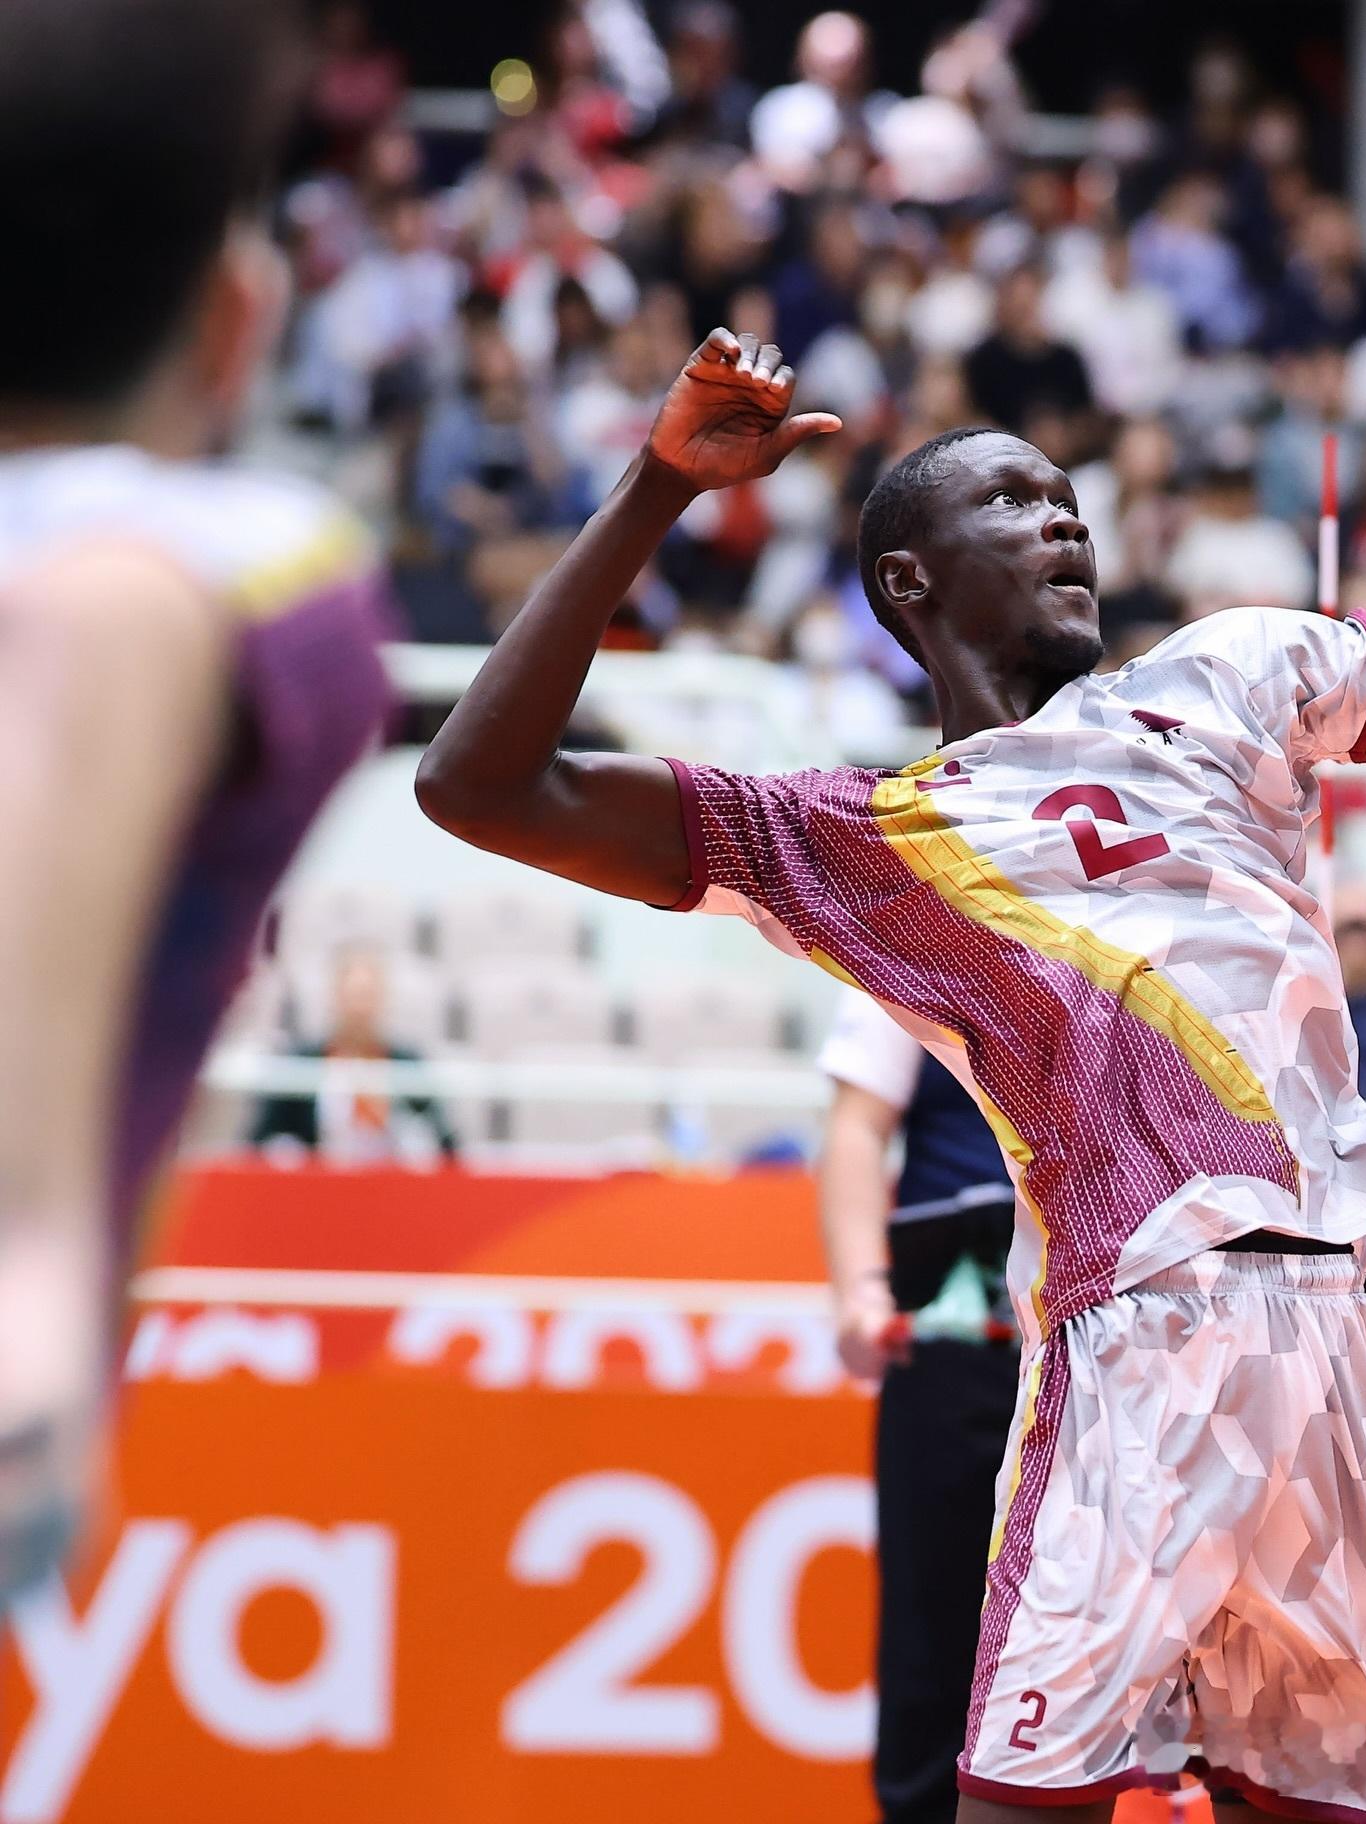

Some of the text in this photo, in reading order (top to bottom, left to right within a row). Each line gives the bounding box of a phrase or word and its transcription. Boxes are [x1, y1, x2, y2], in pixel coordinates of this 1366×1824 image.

[1032, 784, 1171, 882] 2
[0, 1515, 394, 1824] ya
[1008, 1690, 1047, 1752] 2
